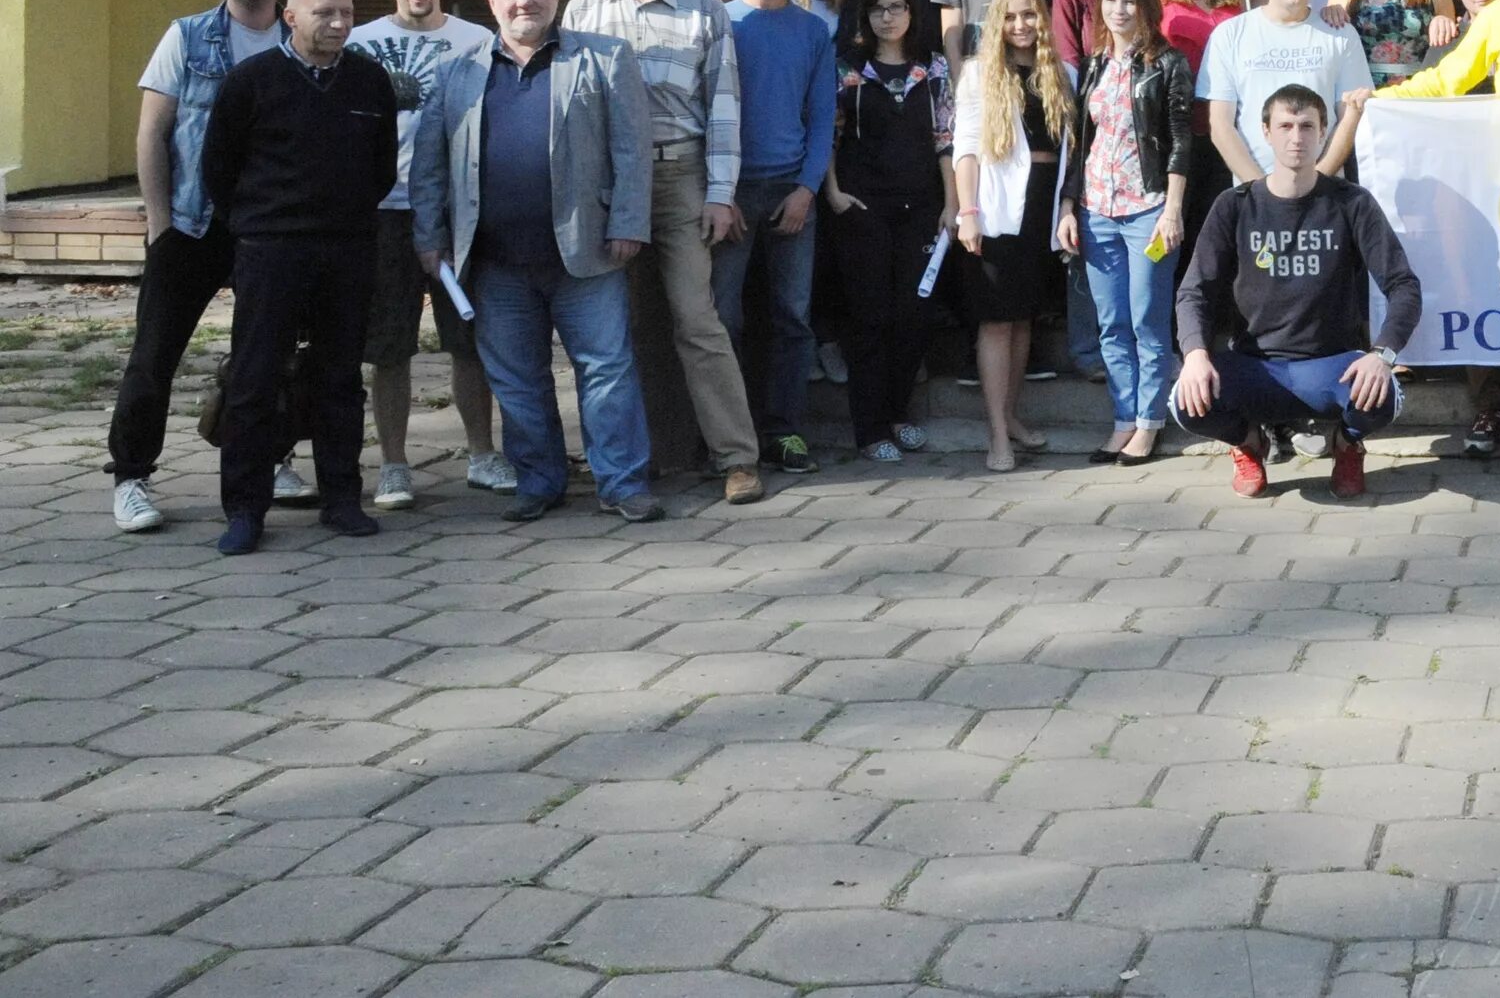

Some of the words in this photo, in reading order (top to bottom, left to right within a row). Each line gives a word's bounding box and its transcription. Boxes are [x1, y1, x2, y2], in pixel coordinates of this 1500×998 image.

[1250, 229, 1293, 252] GAP
[1297, 228, 1340, 251] EST.
[1269, 253, 1321, 278] 1969
